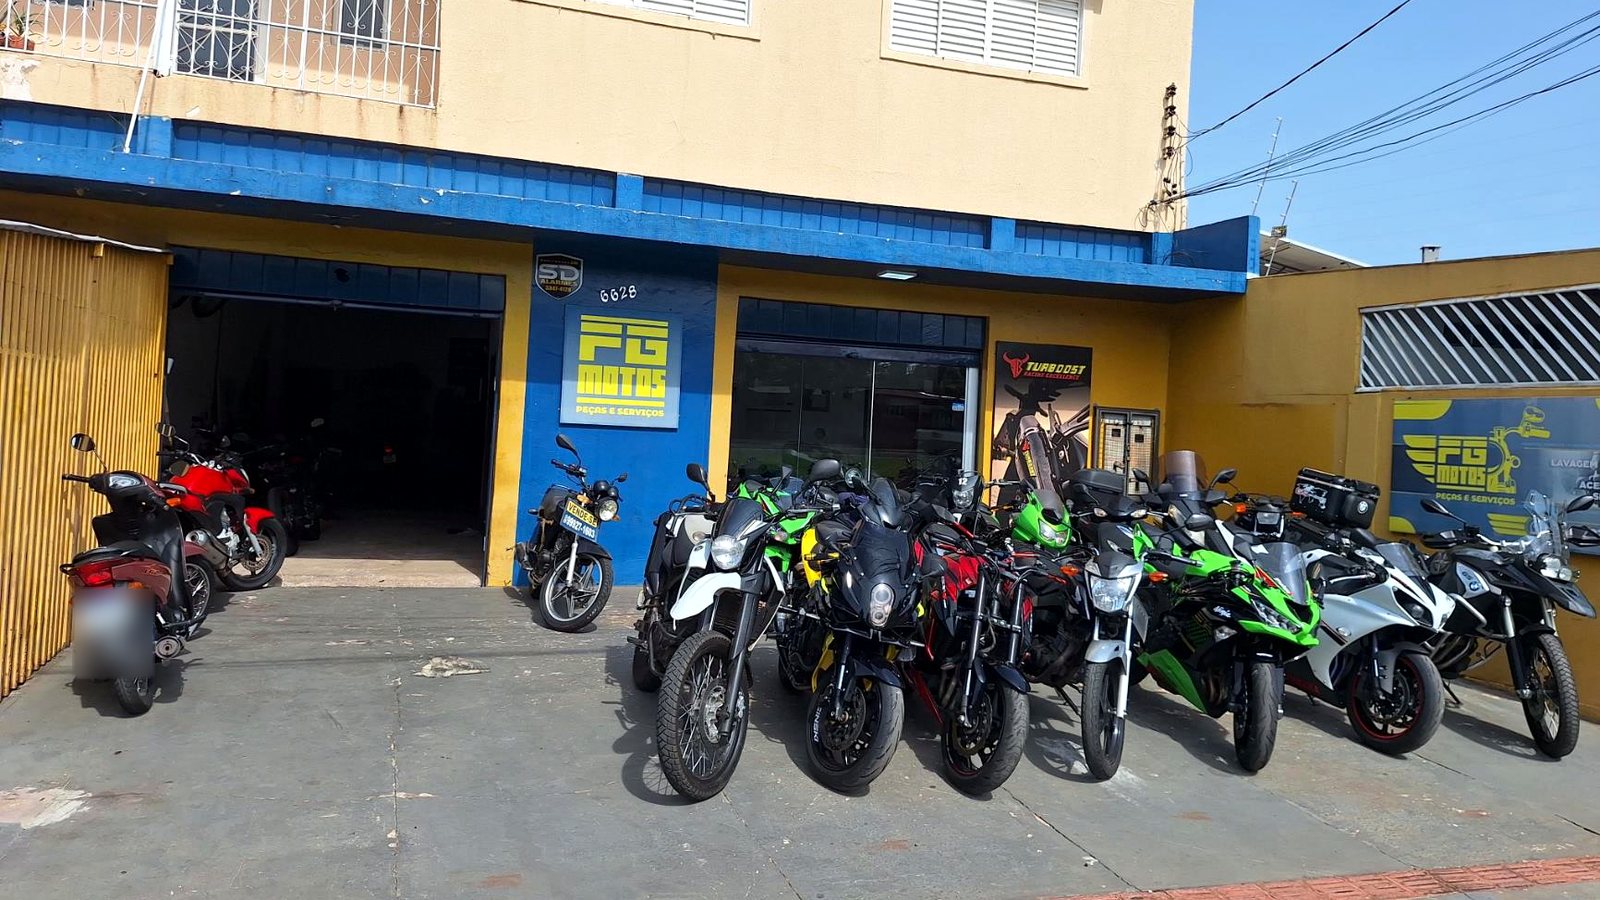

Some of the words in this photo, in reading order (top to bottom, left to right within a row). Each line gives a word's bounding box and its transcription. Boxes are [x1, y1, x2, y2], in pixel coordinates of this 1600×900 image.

[539, 264, 580, 281] SD
[600, 285, 637, 302] 6628
[579, 321, 668, 366] FG
[1026, 361, 1087, 375] TURBOOST
[576, 364, 667, 398] MOTOS
[576, 405, 607, 415] PEÇAS
[609, 407, 615, 415] E
[617, 408, 665, 418] SERVIÇOS
[1437, 440, 1488, 465] FG
[958, 477, 968, 486] 12
[1437, 465, 1487, 486] MOTOS
[1435, 492, 1462, 502] PEÇAS
[1464, 494, 1469, 502] E
[1471, 495, 1516, 506] SERVIÇOS
